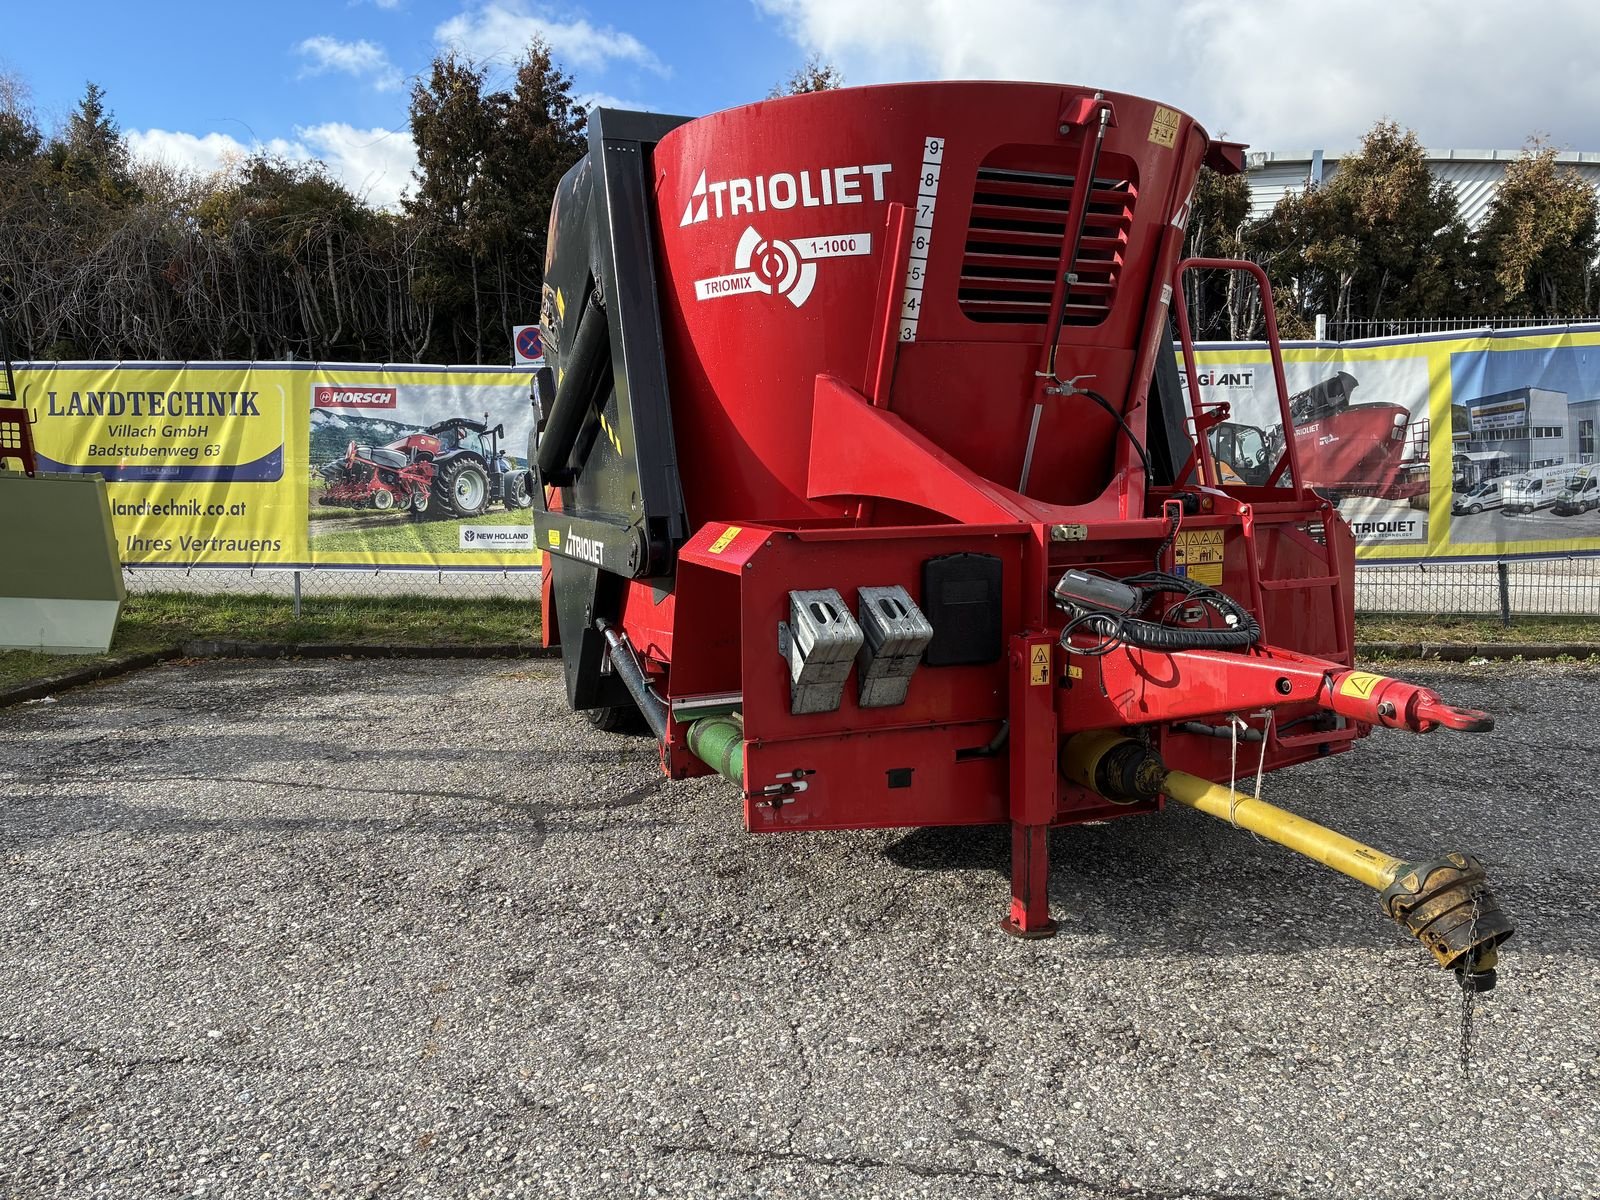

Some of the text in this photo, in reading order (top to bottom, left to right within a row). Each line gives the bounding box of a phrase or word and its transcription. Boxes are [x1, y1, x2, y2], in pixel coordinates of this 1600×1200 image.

[929, 140, 939, 154] 9
[925, 173, 934, 187] 8
[709, 164, 893, 219] TRIOLIET
[922, 204, 930, 218] 7
[810, 238, 856, 255] 1-1000
[916, 236, 925, 250] 6
[912, 267, 920, 280] 5
[704, 276, 752, 295] TRIOMIX
[907, 298, 916, 311] 4
[903, 328, 912, 340] 3
[47, 392, 261, 416] LANDTECHNIK
[332, 392, 392, 404] HORSCH
[108, 424, 209, 438] Villach GmbH
[88, 444, 221, 460] Badstubenweg 63
[112, 498, 246, 516] landtechnik.co.at
[1353, 521, 1416, 534] TRIOLIET
[126, 535, 282, 552] Ihres Vertrauens
[571, 534, 604, 566] TRIOLIET
